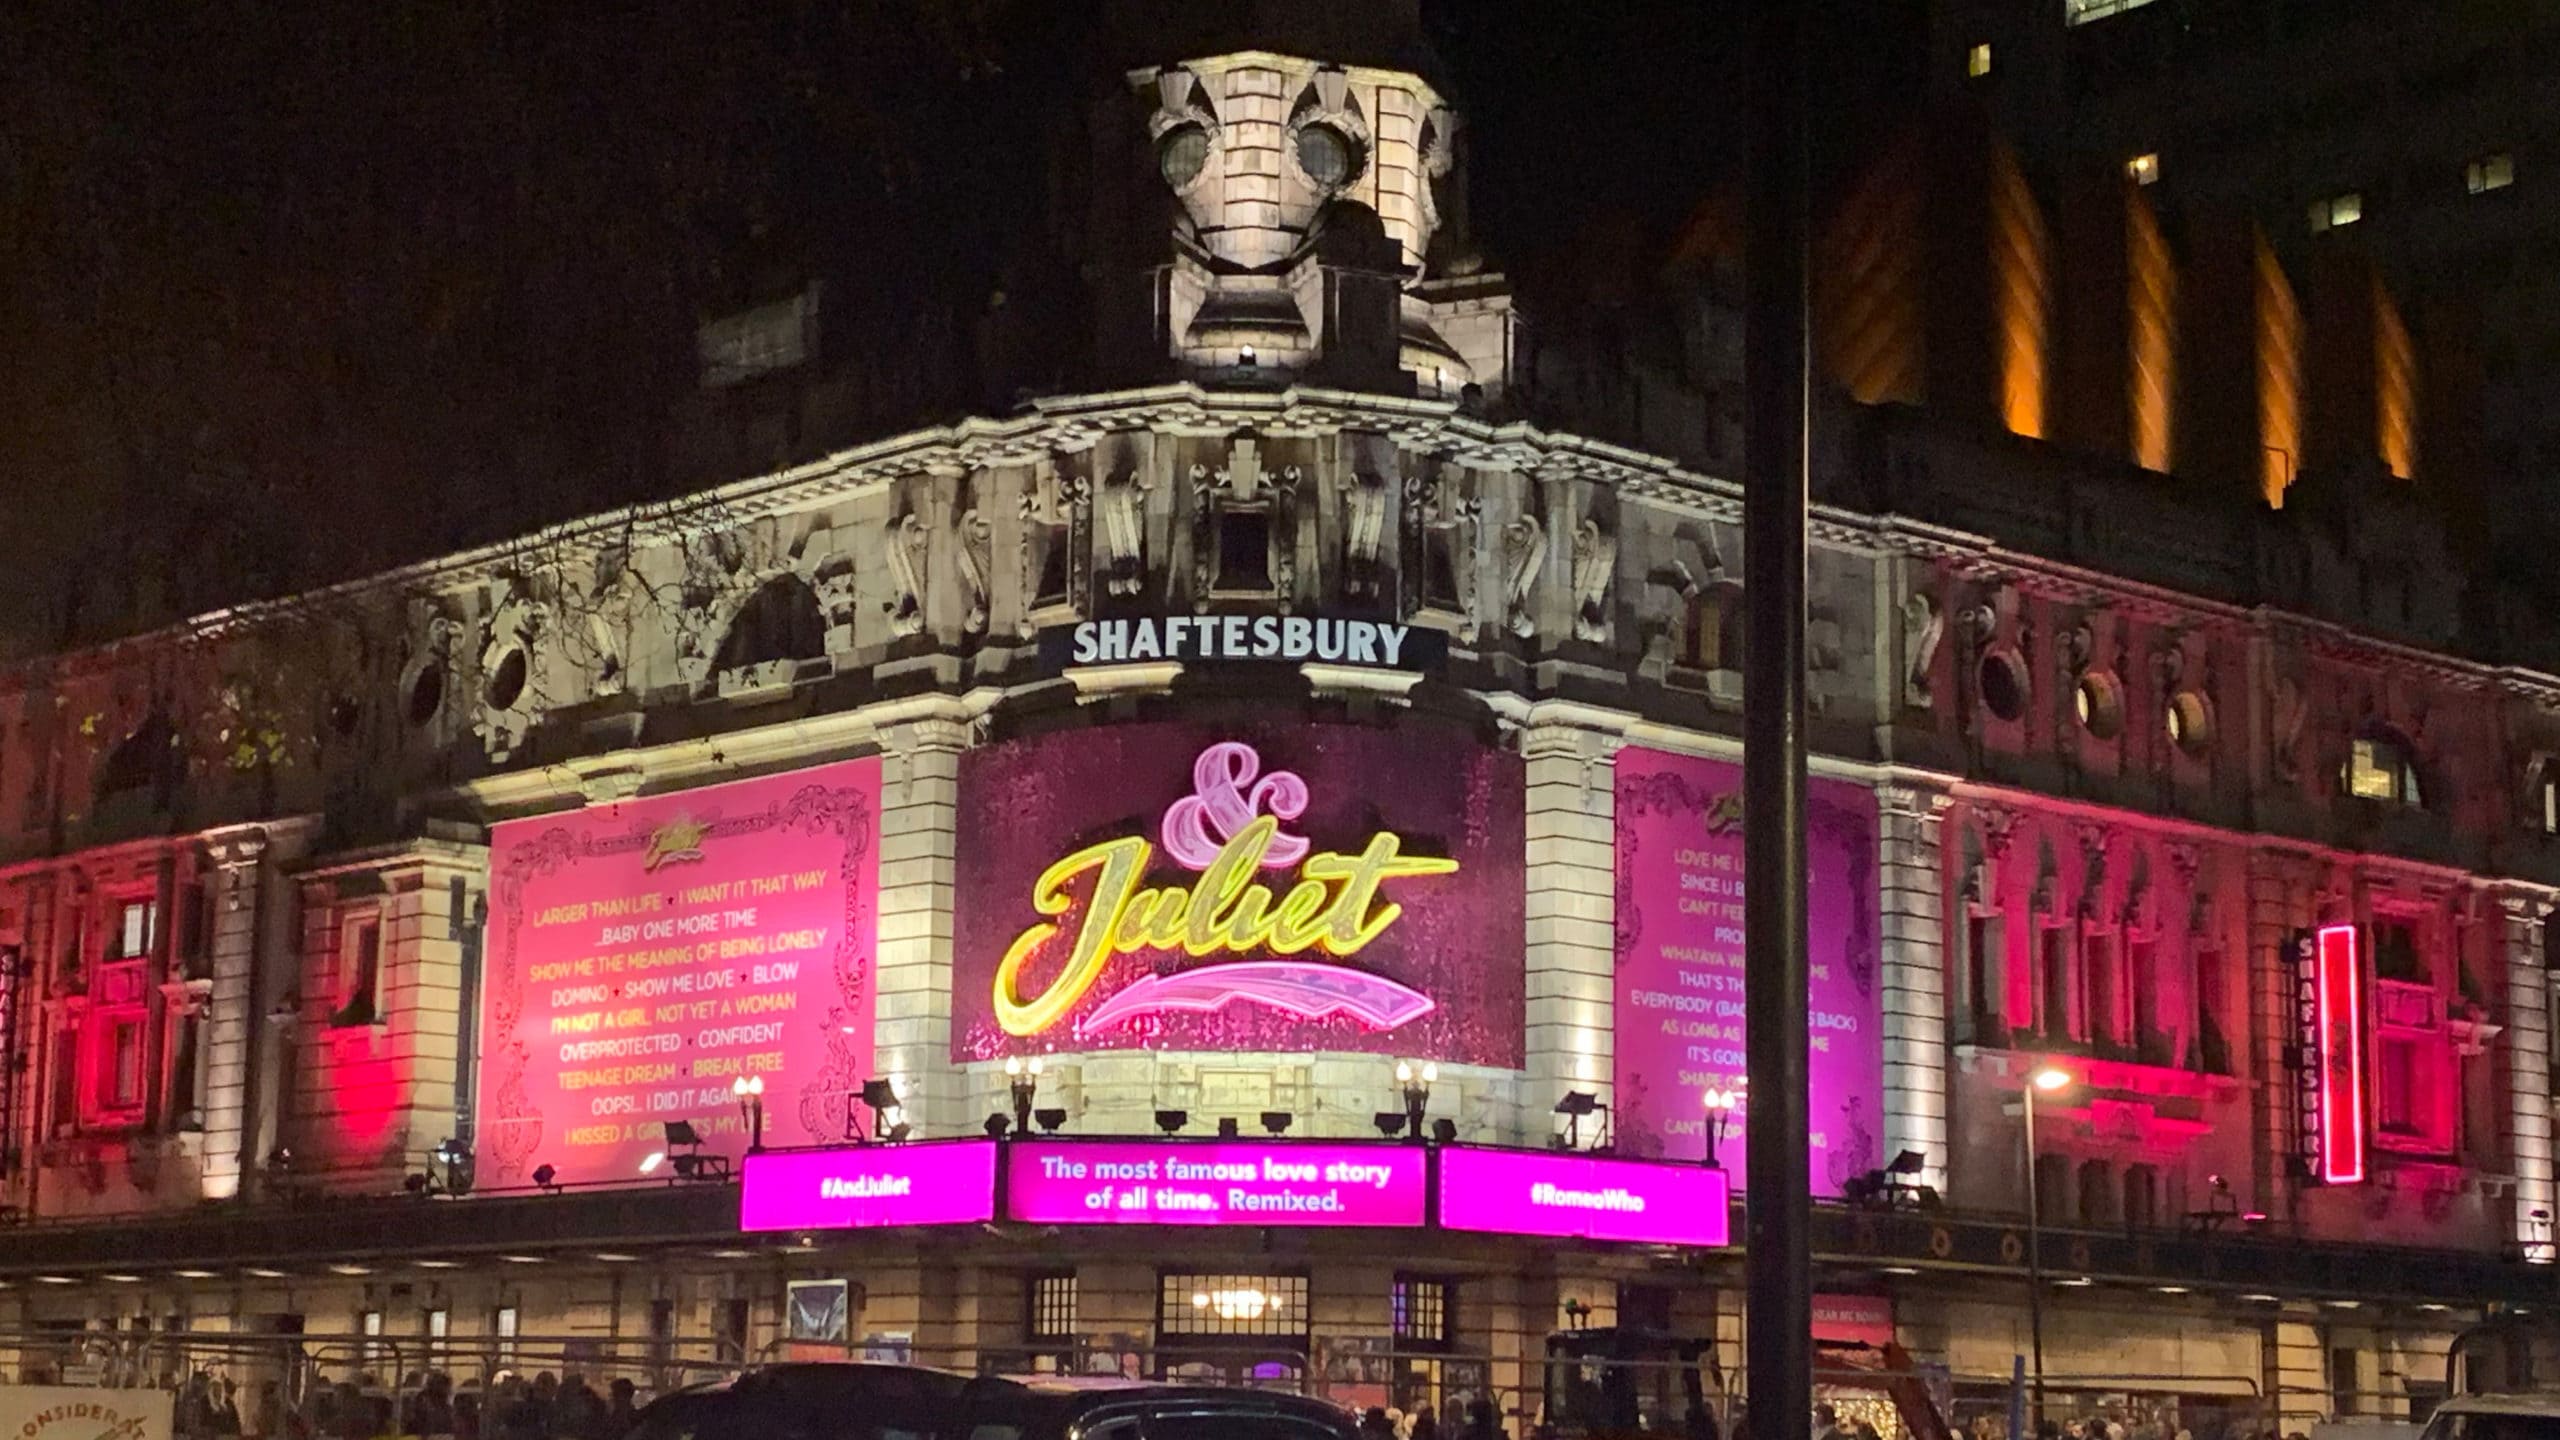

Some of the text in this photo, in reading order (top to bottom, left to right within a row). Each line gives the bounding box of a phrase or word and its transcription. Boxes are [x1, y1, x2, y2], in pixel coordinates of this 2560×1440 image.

[1073, 615, 1408, 665] SHAFTESBURY
[1162, 741, 1310, 870] &
[1674, 848, 1711, 869] LOVE
[1712, 854, 1733, 871] ME
[533, 870, 827, 928] LARGER THAN LIFE I WANT IT THAT WAY
[1680, 872, 1720, 893] SINCE
[1722, 879, 1733, 896] U
[643, 919, 674, 940] ONE
[677, 913, 719, 935] MORE
[723, 908, 757, 928] TIME
[993, 815, 1460, 1036] Juliet
[530, 928, 828, 983] SHOW ME THE MEANING OF BEING LONELY
[552, 962, 799, 1008] DOMINO SHOW ME LOVE BLOW
[1678, 970, 1724, 991] THAT'S
[572, 1012, 601, 1032] NOT
[604, 1011, 615, 1028] A
[655, 1003, 687, 1024] NOT
[690, 1000, 717, 1020] YET
[720, 1001, 732, 1018] A
[735, 992, 797, 1015] WOMAN
[1631, 989, 1713, 1014] EVERYBODY
[559, 1022, 784, 1062] OVERPROTECTED CONFIDENT
[1661, 1018, 1679, 1035] AS
[1683, 1021, 1720, 1040] LONG
[1722, 1024, 1741, 1042] AS
[1687, 1046, 1711, 1063] IT'S
[558, 1052, 784, 1089] TEENAGE DREAM BREAK FREE
[1678, 1069, 1722, 1089] SHAPE
[653, 1091, 679, 1111] DID
[682, 1089, 695, 1109] IT
[571, 1125, 620, 1146] KISSED
[623, 1125, 634, 1141] A
[637, 1120, 666, 1141] GIR
[715, 1116, 737, 1135] MY
[821, 1173, 911, 1199] #AndJuliet
[1041, 1156, 1392, 1189] The most famous love story
[1084, 1185, 1345, 1212] of all time. Remixed.
[1531, 1182, 1645, 1213] #RomeoWho
